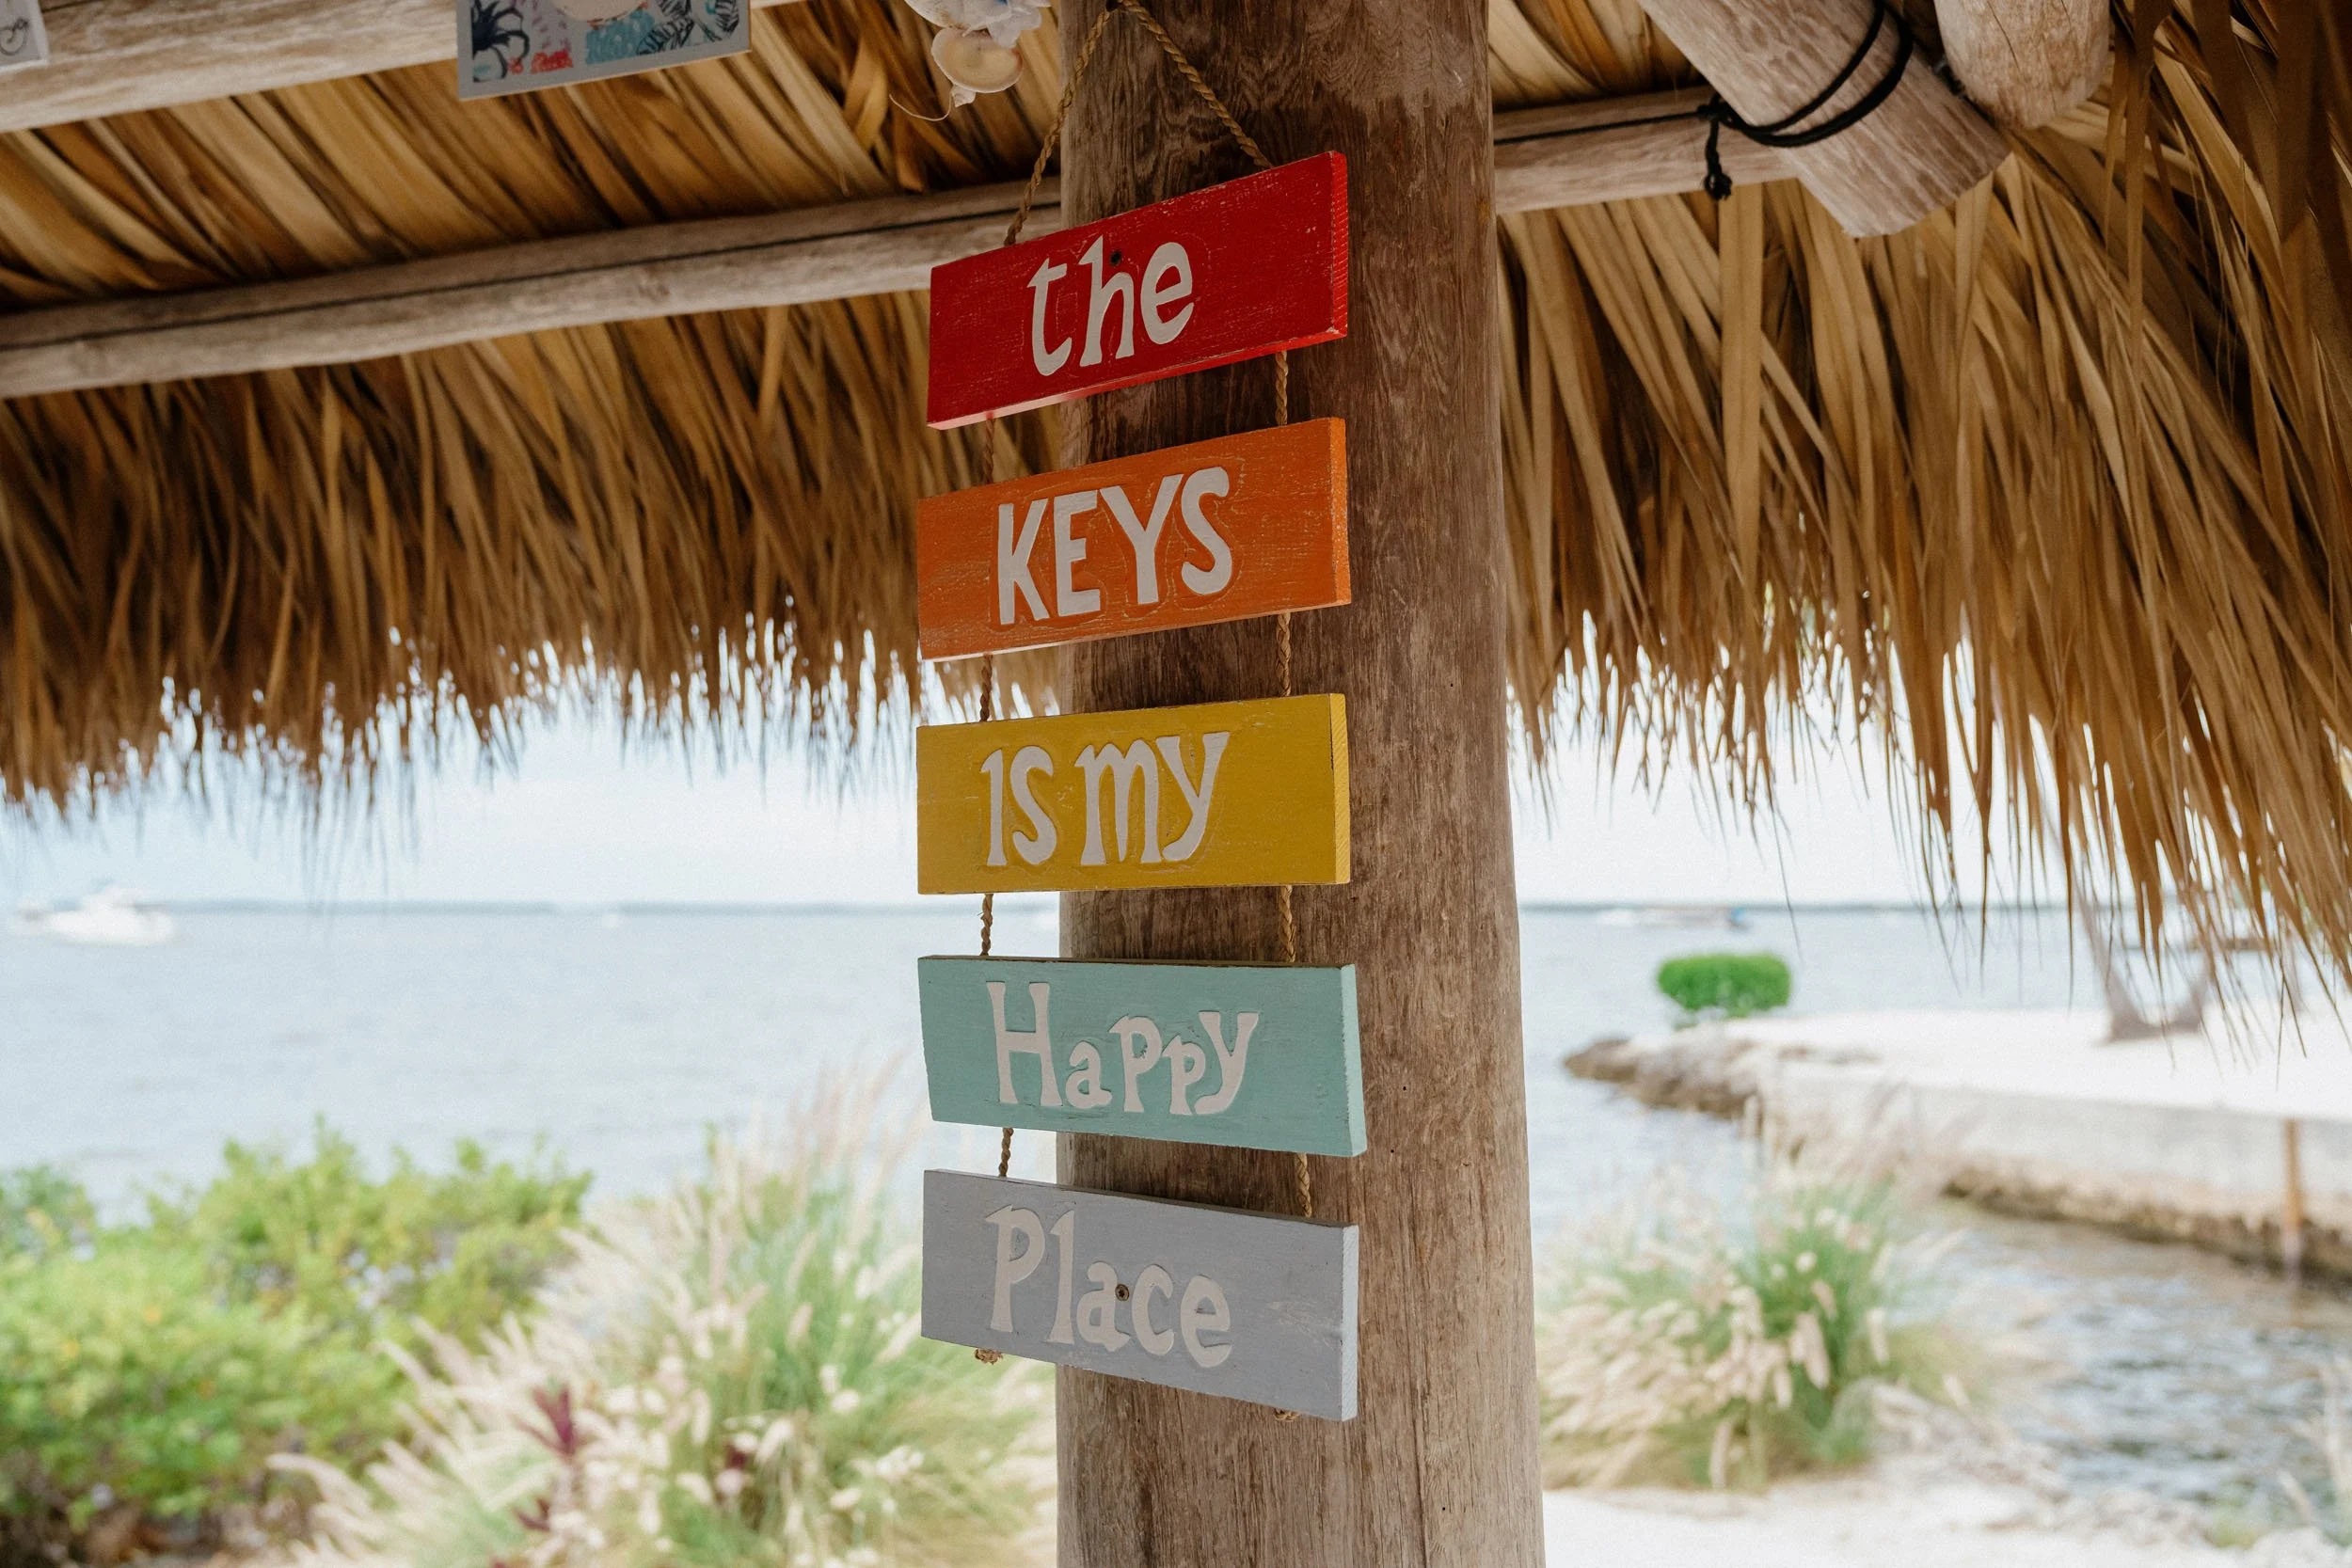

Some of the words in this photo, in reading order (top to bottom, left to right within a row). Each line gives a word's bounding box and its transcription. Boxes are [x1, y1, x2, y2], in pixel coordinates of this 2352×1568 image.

[1027, 235, 1195, 376] the
[997, 467, 1232, 625] KEYS
[1074, 732, 1231, 866] my
[986, 981, 1260, 1116] Happy
[985, 1204, 1232, 1369] Place
